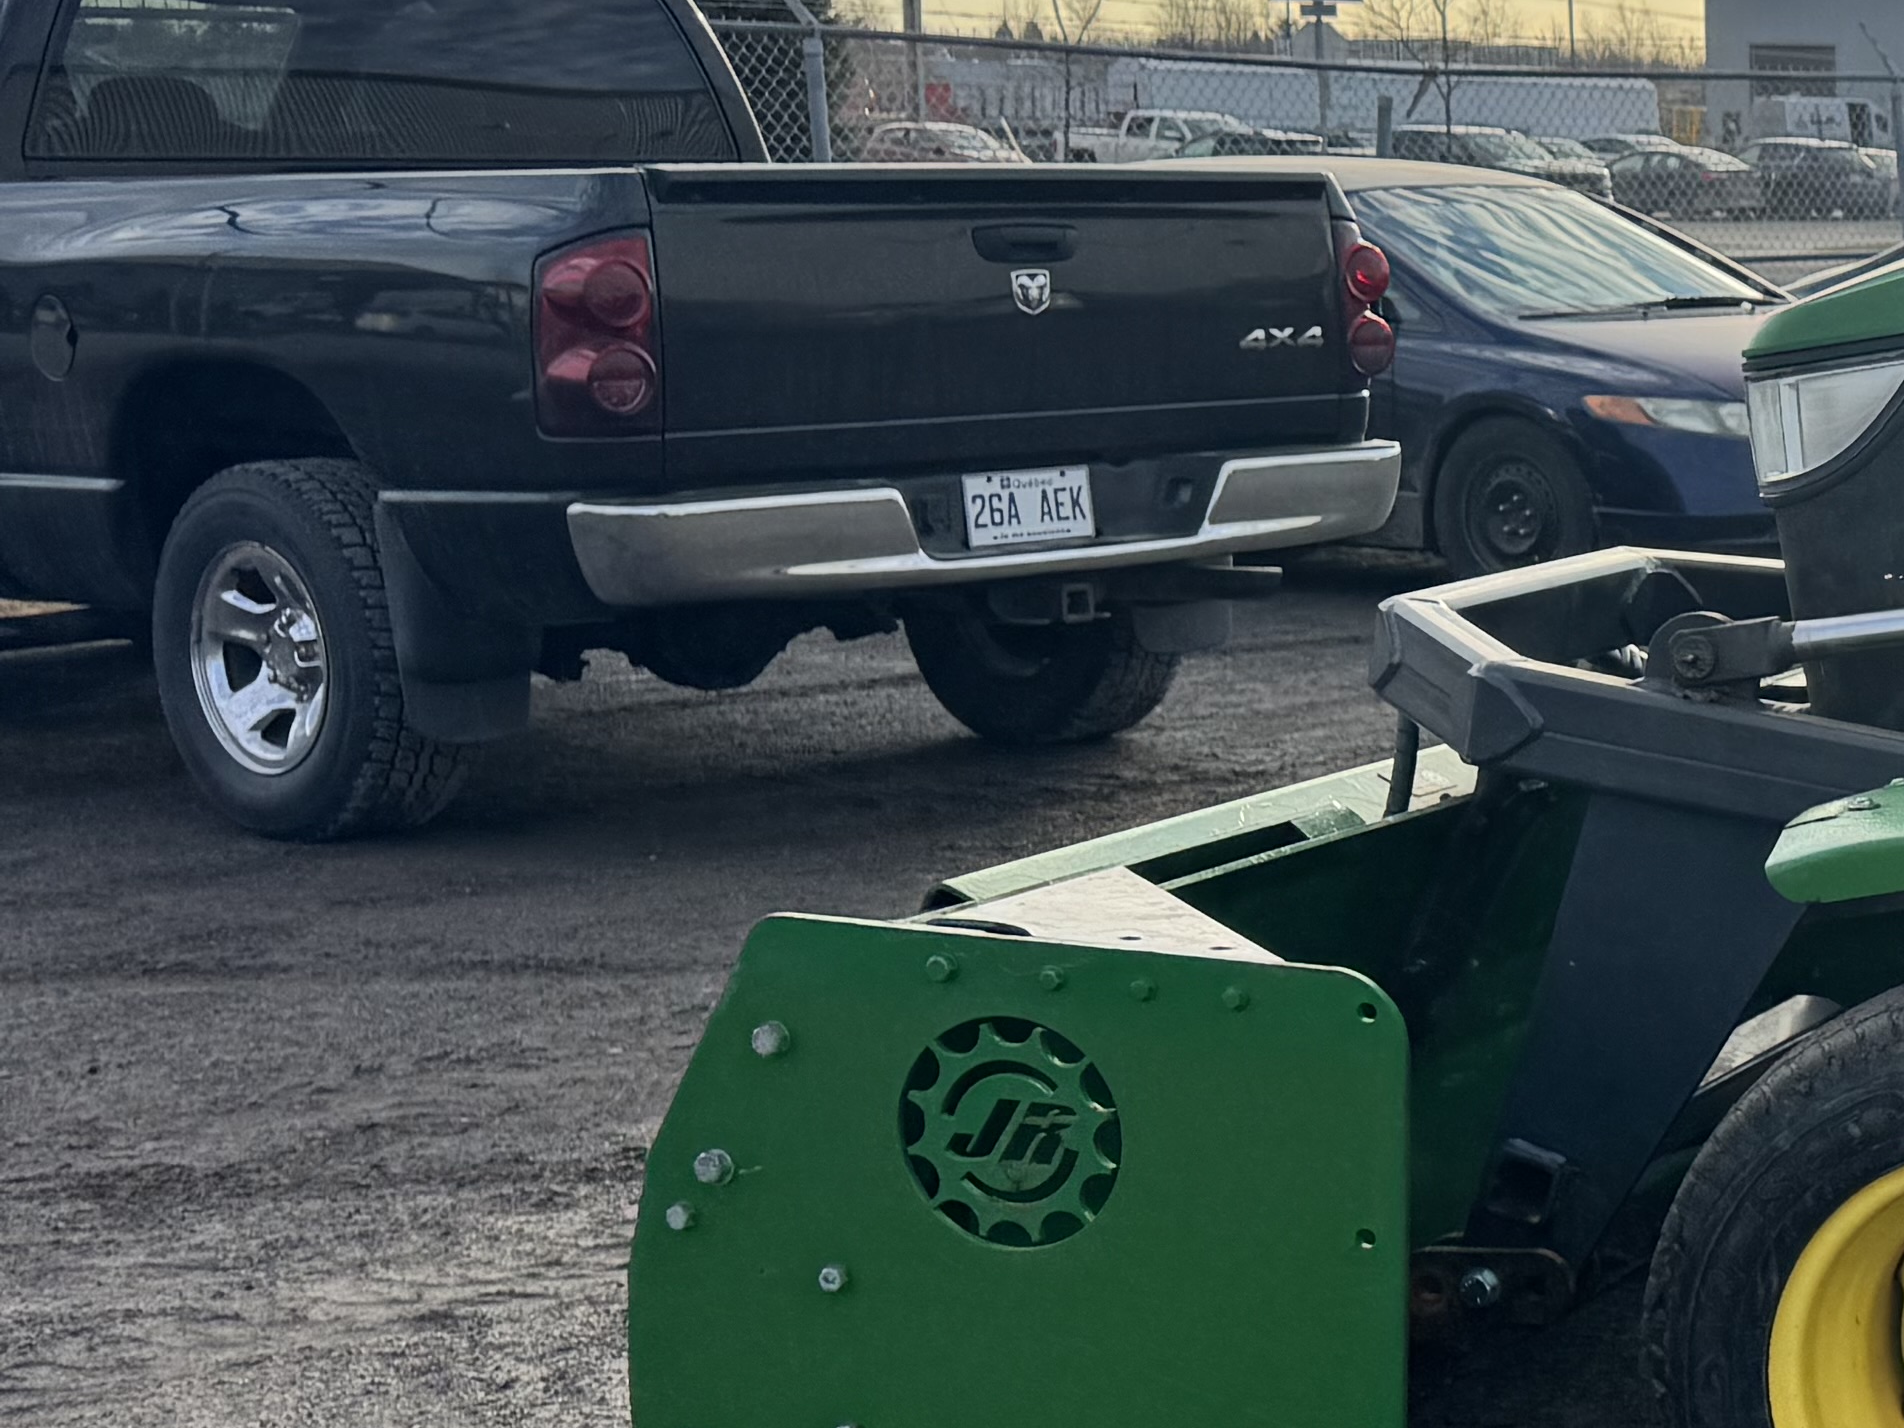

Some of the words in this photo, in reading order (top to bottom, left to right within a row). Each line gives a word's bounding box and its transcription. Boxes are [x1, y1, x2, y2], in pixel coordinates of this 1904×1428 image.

[971, 491, 1021, 529] 26A
[1040, 485, 1086, 523] AEK
[945, 1098, 1079, 1165] JR
